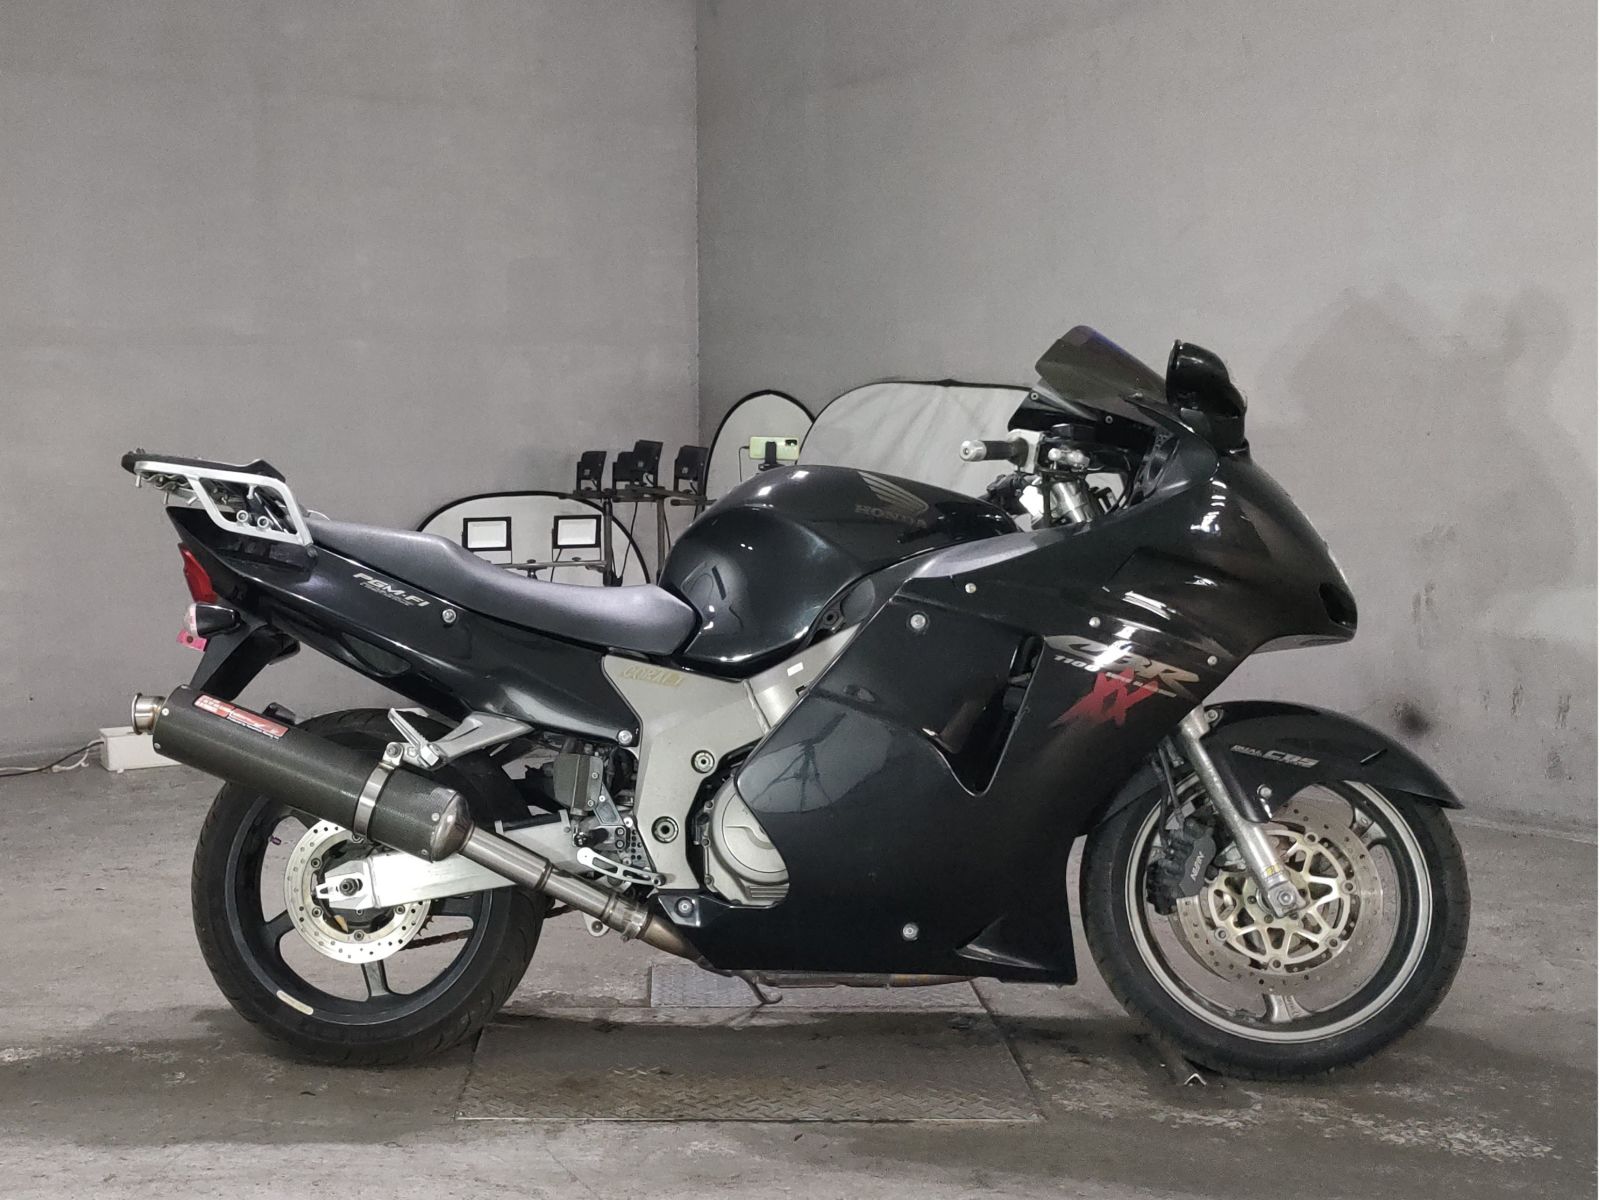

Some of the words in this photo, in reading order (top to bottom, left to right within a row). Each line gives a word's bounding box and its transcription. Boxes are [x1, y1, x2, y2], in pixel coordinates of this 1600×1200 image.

[854, 504, 928, 529] HONDA
[352, 572, 431, 607] PGM-FI
[1043, 634, 1200, 701] CBR
[1053, 654, 1101, 673] 1100
